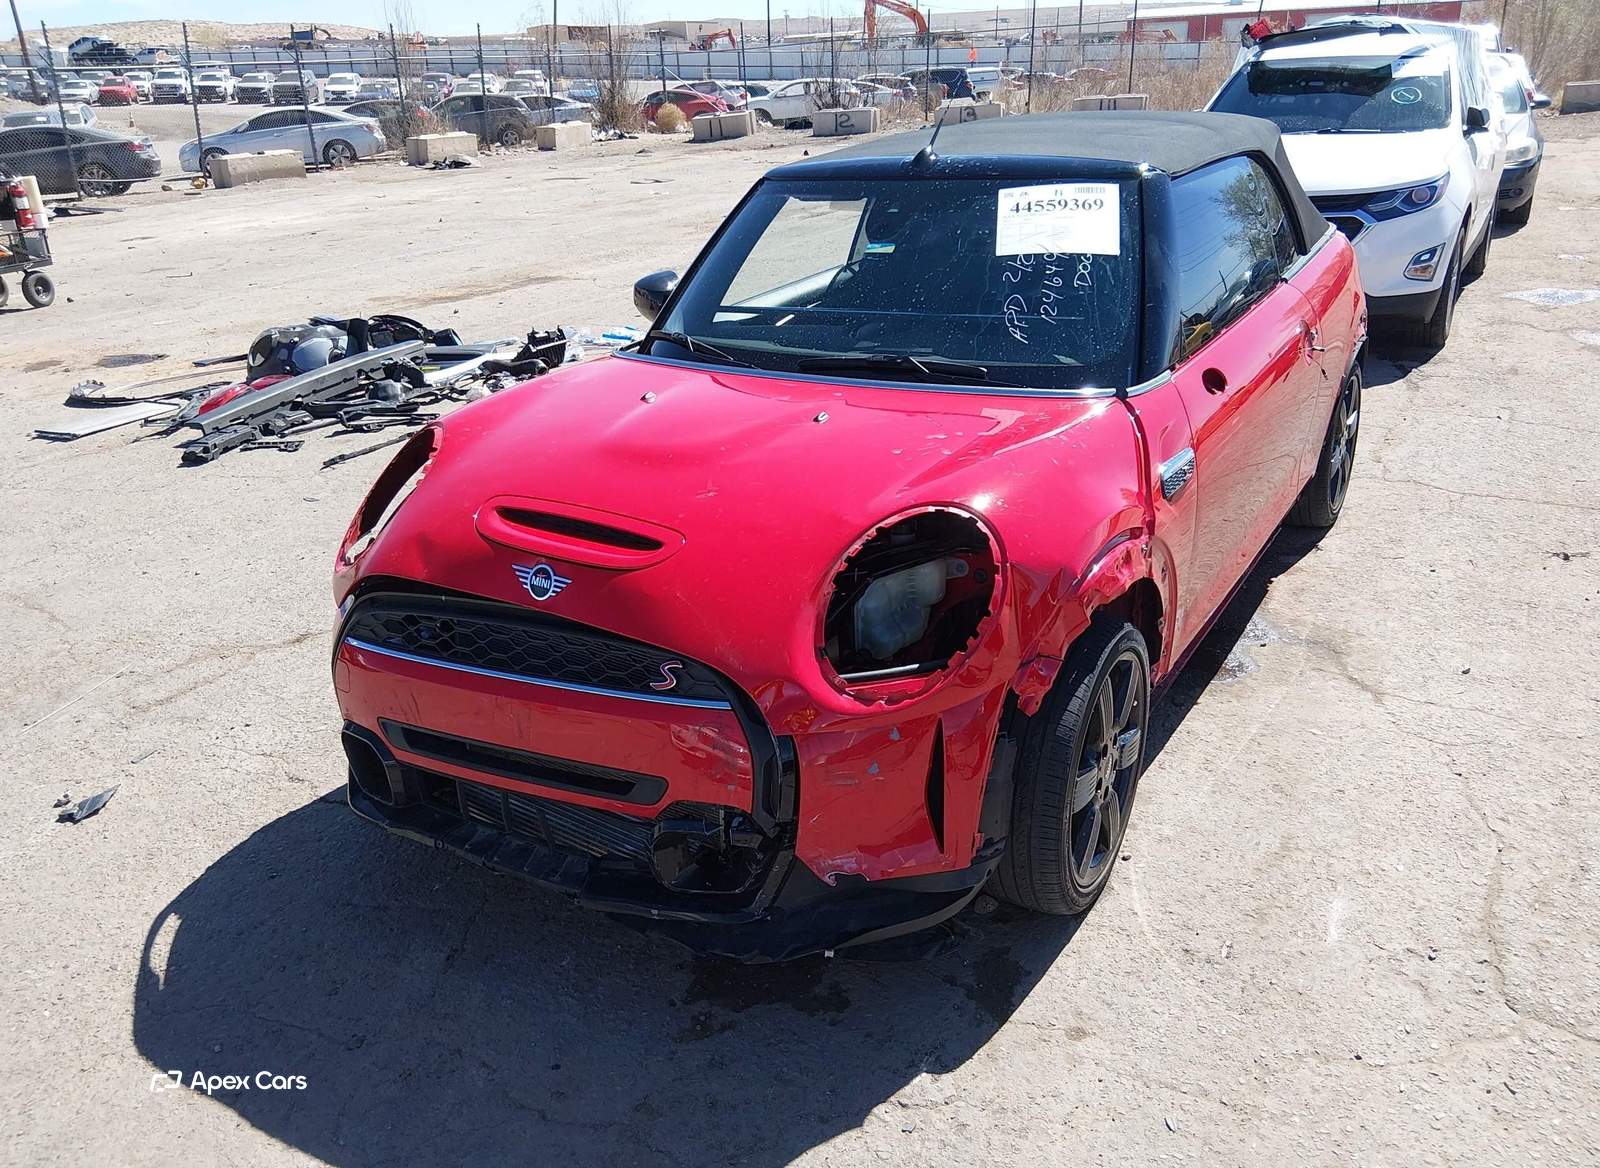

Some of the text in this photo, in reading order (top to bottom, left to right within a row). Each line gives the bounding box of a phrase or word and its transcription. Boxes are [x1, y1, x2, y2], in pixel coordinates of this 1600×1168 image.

[709, 118, 723, 138] 11
[835, 113, 855, 133] 12
[1010, 198, 1104, 214] 44559369
[1004, 294, 1029, 344] APD
[531, 575, 551, 590] MINI
[650, 660, 683, 690] S
